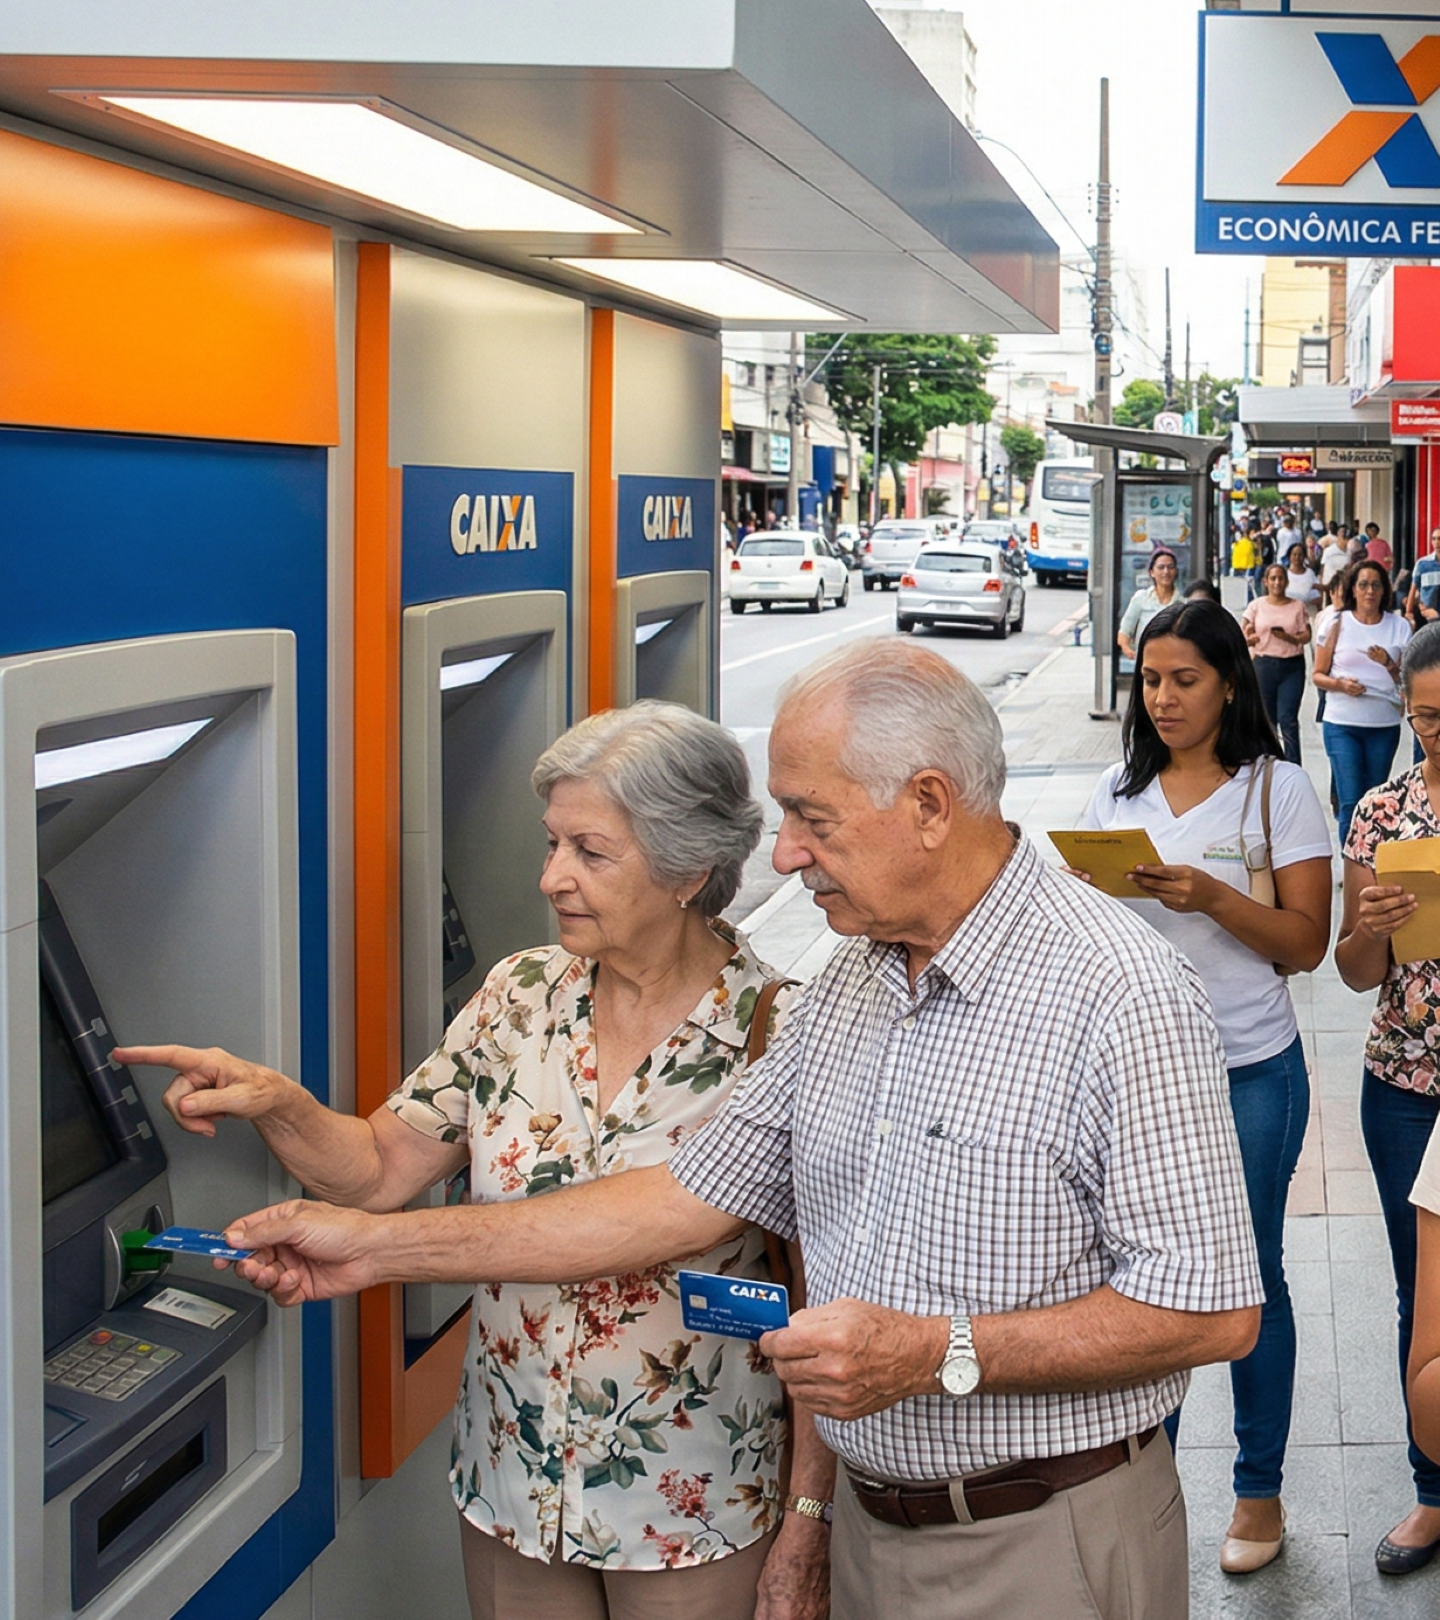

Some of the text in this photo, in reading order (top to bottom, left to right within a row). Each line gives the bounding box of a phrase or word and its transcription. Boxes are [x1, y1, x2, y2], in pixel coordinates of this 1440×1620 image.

[1218, 212, 1401, 244] ECONÔMICA
[450, 493, 538, 556] CAIXA
[643, 495, 693, 541] CAIXA
[729, 1284, 781, 1303] CAIXA
